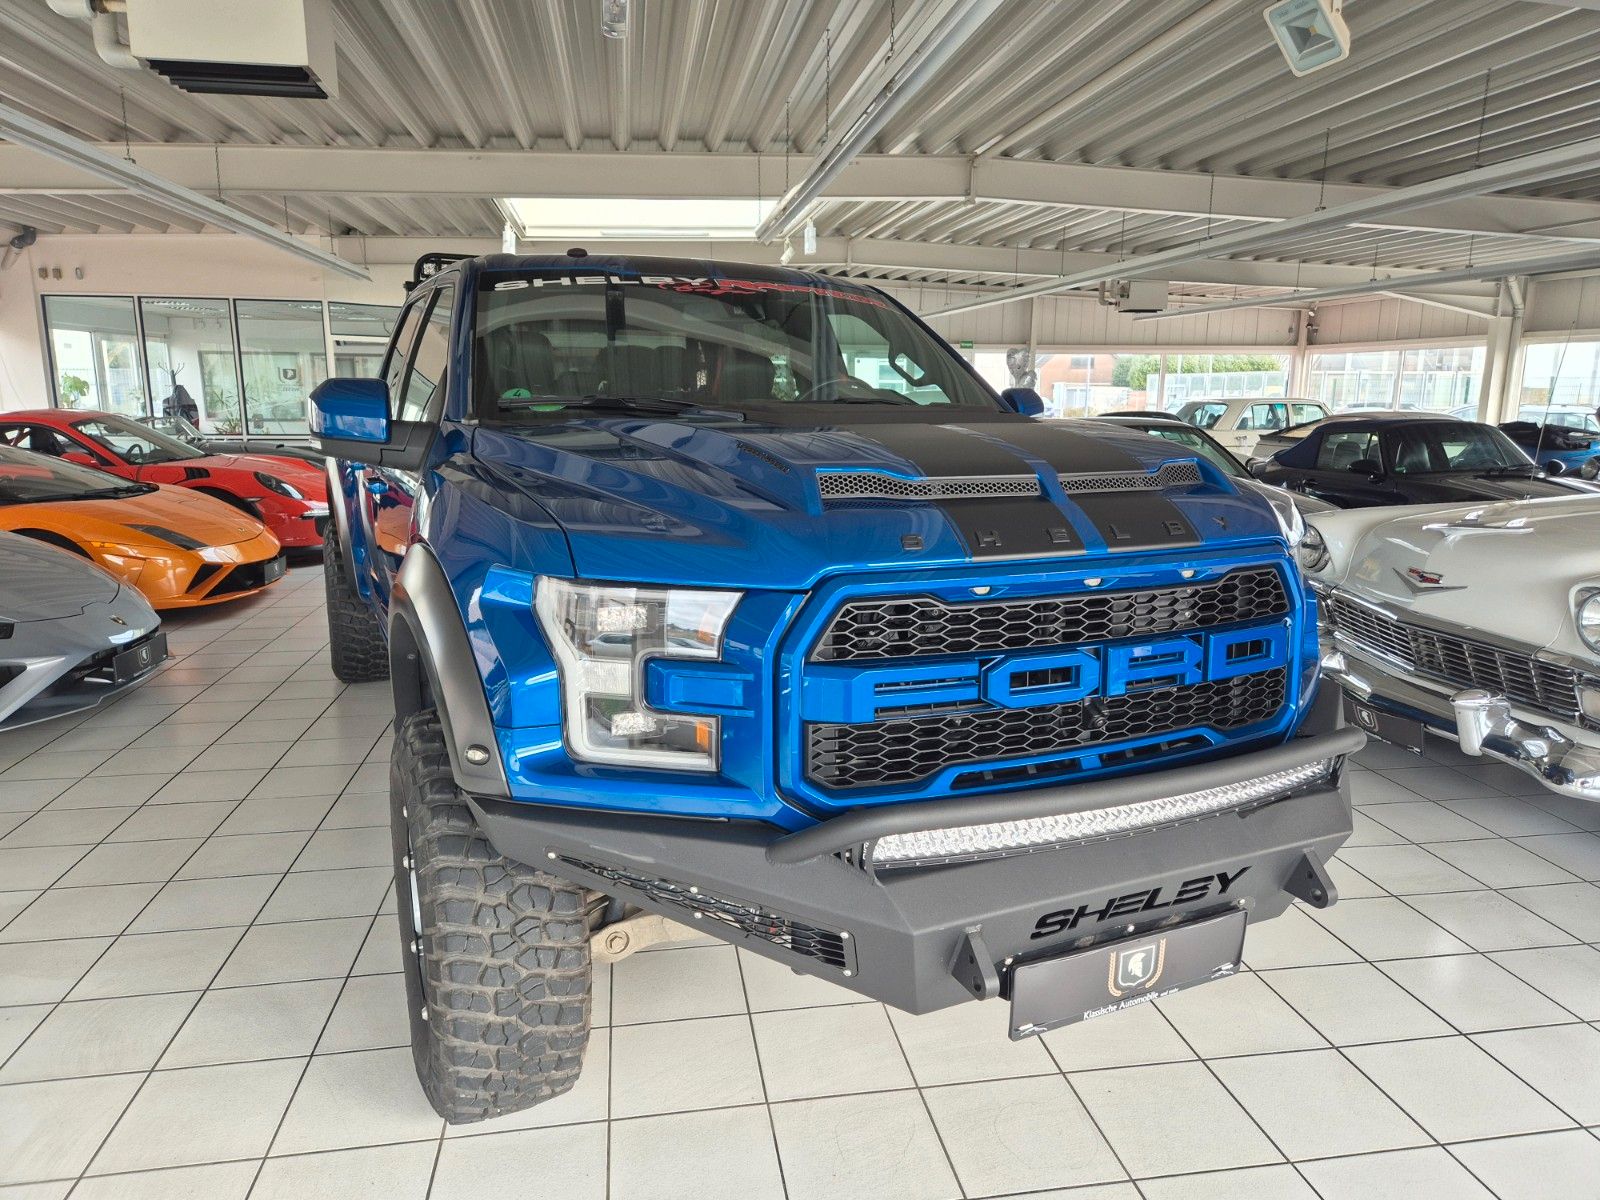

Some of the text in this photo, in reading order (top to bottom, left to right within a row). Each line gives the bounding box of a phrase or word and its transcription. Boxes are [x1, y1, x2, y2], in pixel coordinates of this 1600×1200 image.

[494, 275, 709, 291] SHELBY
[513, 389, 522, 398] 4
[802, 624, 1288, 724] FORD
[1030, 865, 1253, 940] SHELBY
[1083, 1003, 1118, 1021] Klassische
[1119, 991, 1159, 1010] Automobile
